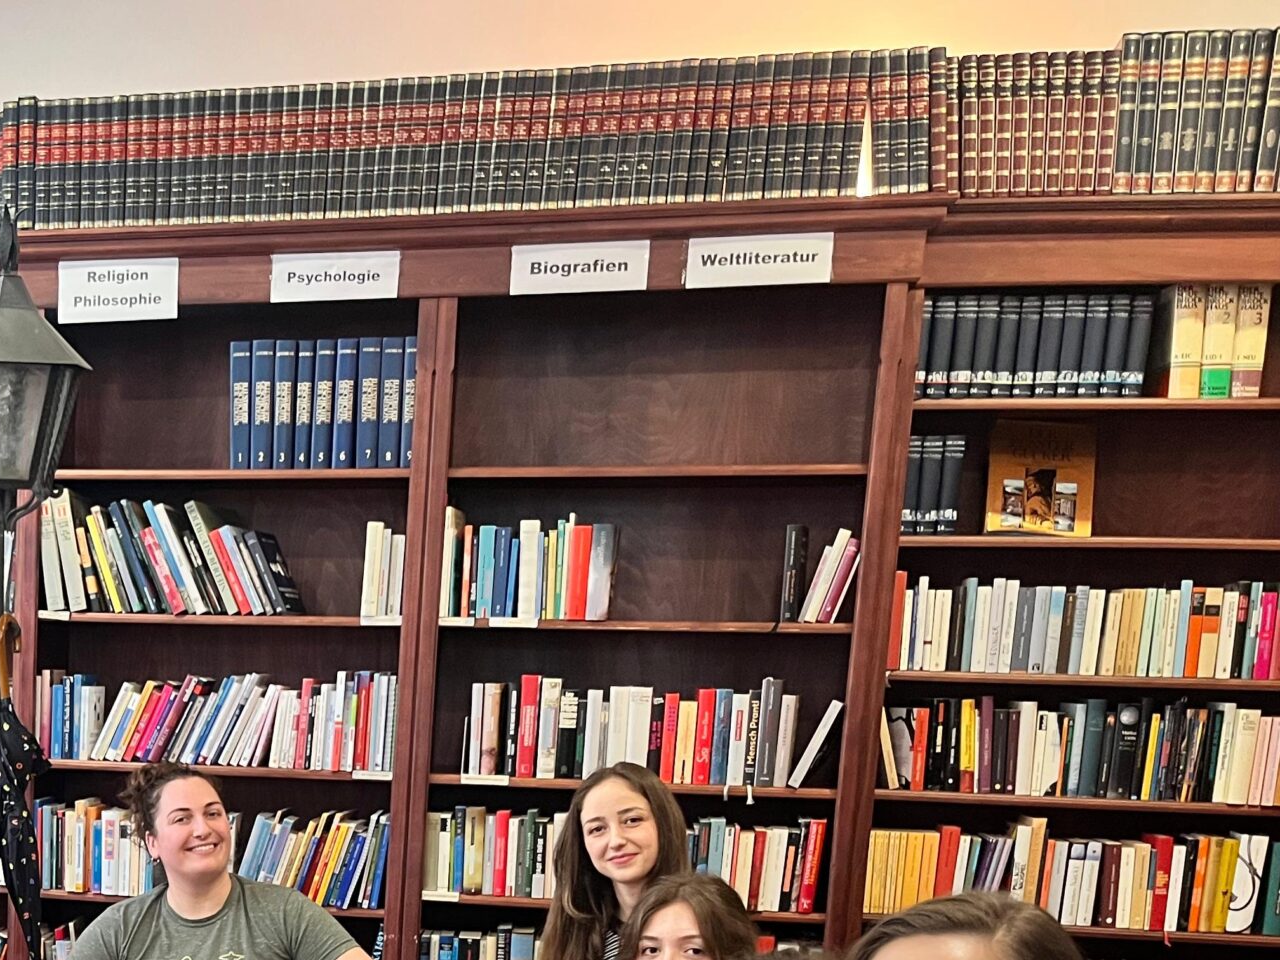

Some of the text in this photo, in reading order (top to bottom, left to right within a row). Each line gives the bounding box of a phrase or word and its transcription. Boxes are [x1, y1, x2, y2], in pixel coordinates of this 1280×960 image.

[700, 250, 819, 267] Weltliteratur
[529, 259, 629, 278] Biografien
[87, 269, 149, 285] Religion
[287, 269, 381, 287] Psychologie
[73, 292, 162, 309] Philosophie
[1254, 312, 1262, 325] 3
[238, 453, 242, 462] 1
[258, 451, 264, 462] 2
[279, 452, 285, 462] 3
[299, 452, 305, 462] 4
[318, 452, 324, 462] 5
[339, 451, 346, 461] 6
[365, 449, 371, 459] 7
[385, 452, 392, 461] 8
[746, 700, 760, 764] Mensch Prantl
